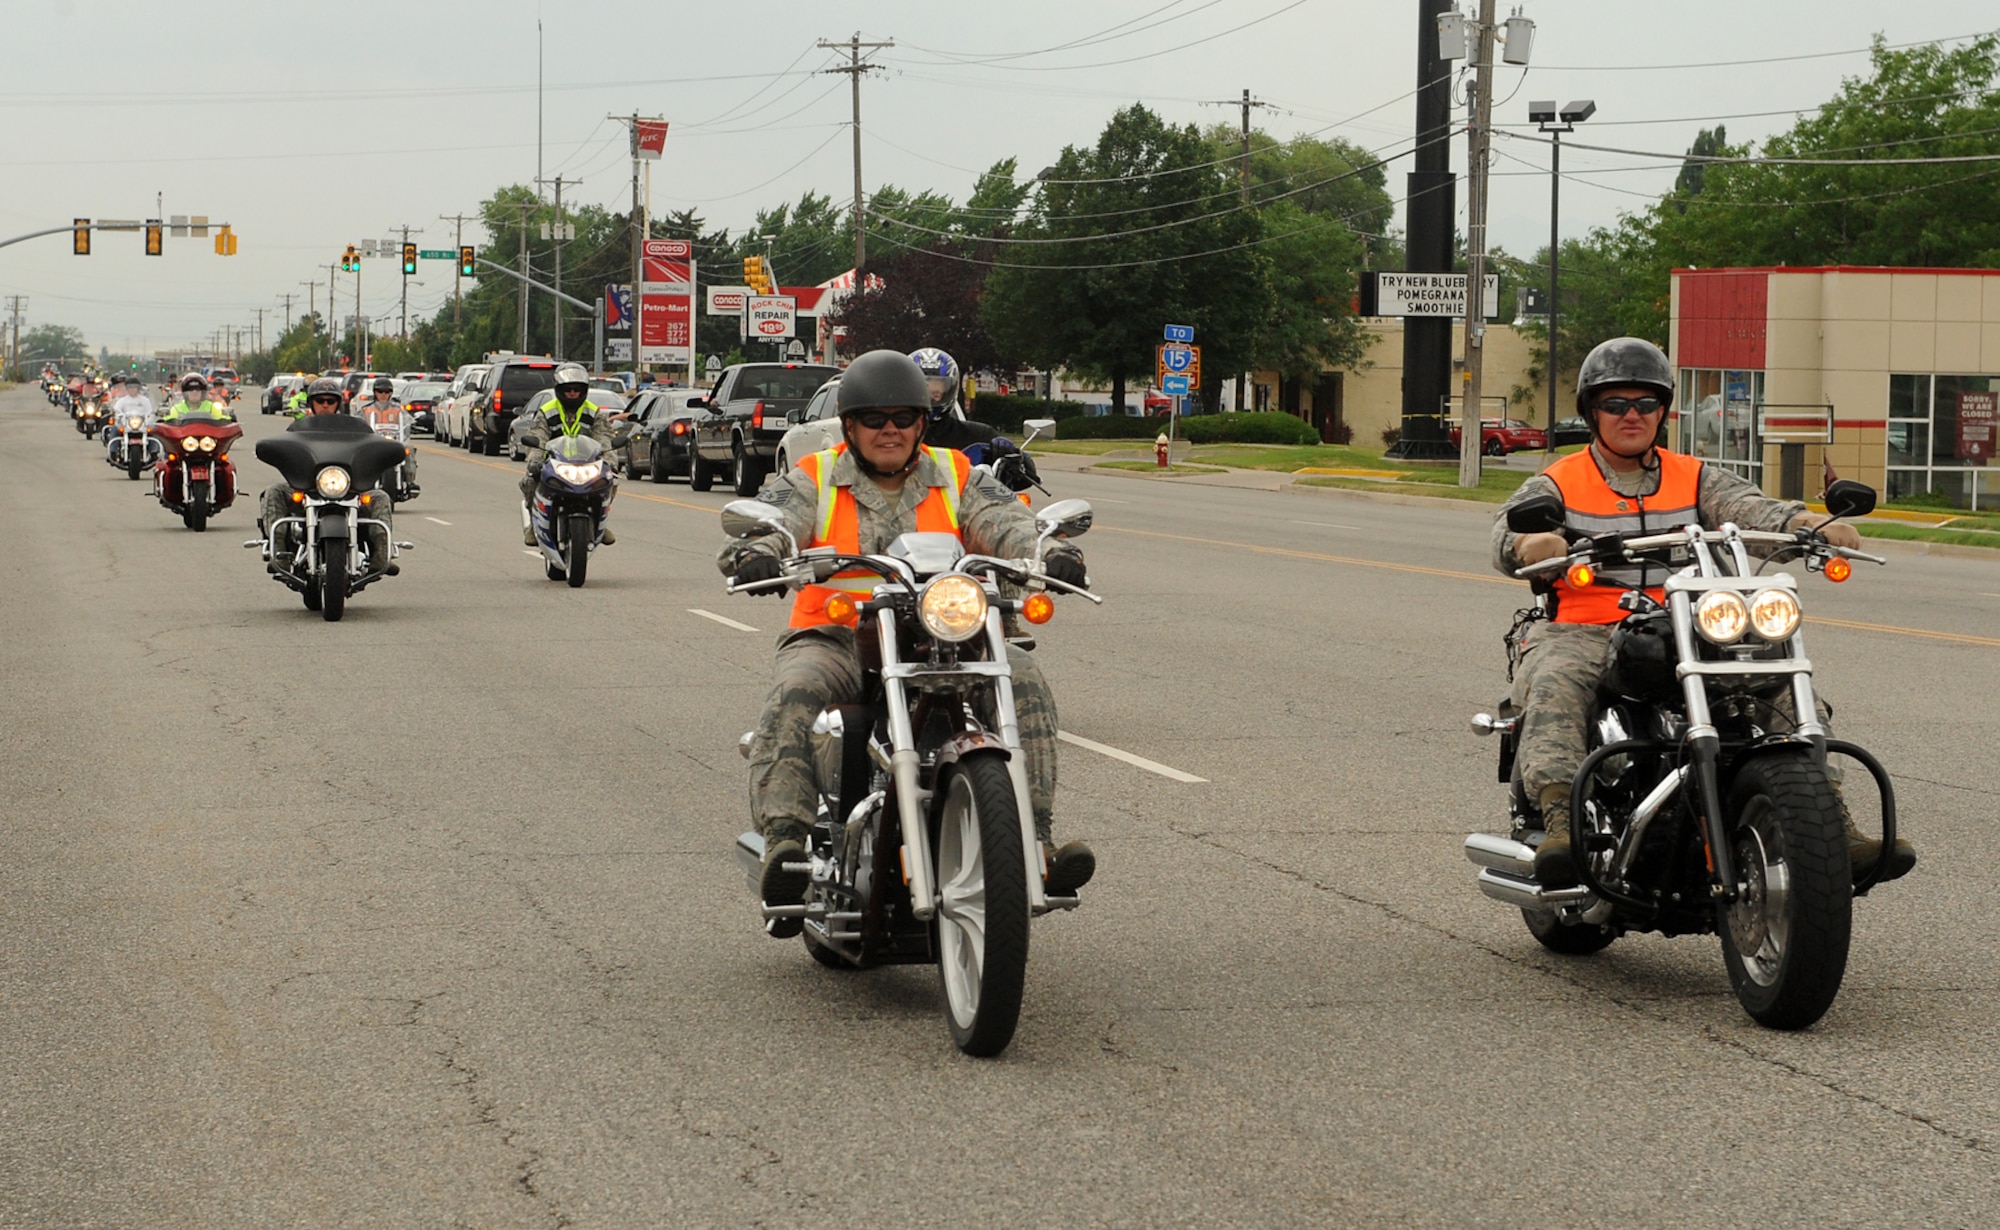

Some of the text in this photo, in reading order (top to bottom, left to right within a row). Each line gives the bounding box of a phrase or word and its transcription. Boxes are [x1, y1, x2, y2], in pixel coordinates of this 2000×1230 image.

[1382, 276, 1495, 288] TRY NEW BLUEBY
[1397, 289, 1467, 301] POMEGRANA
[643, 304, 688, 312] Petro-Mart
[751, 300, 794, 311] ROCK CHIP
[1407, 302, 1464, 313] SMOOTHIE
[754, 311, 790, 320] REPAIR
[1171, 328, 1186, 338] TO
[1169, 351, 1186, 367] 15
